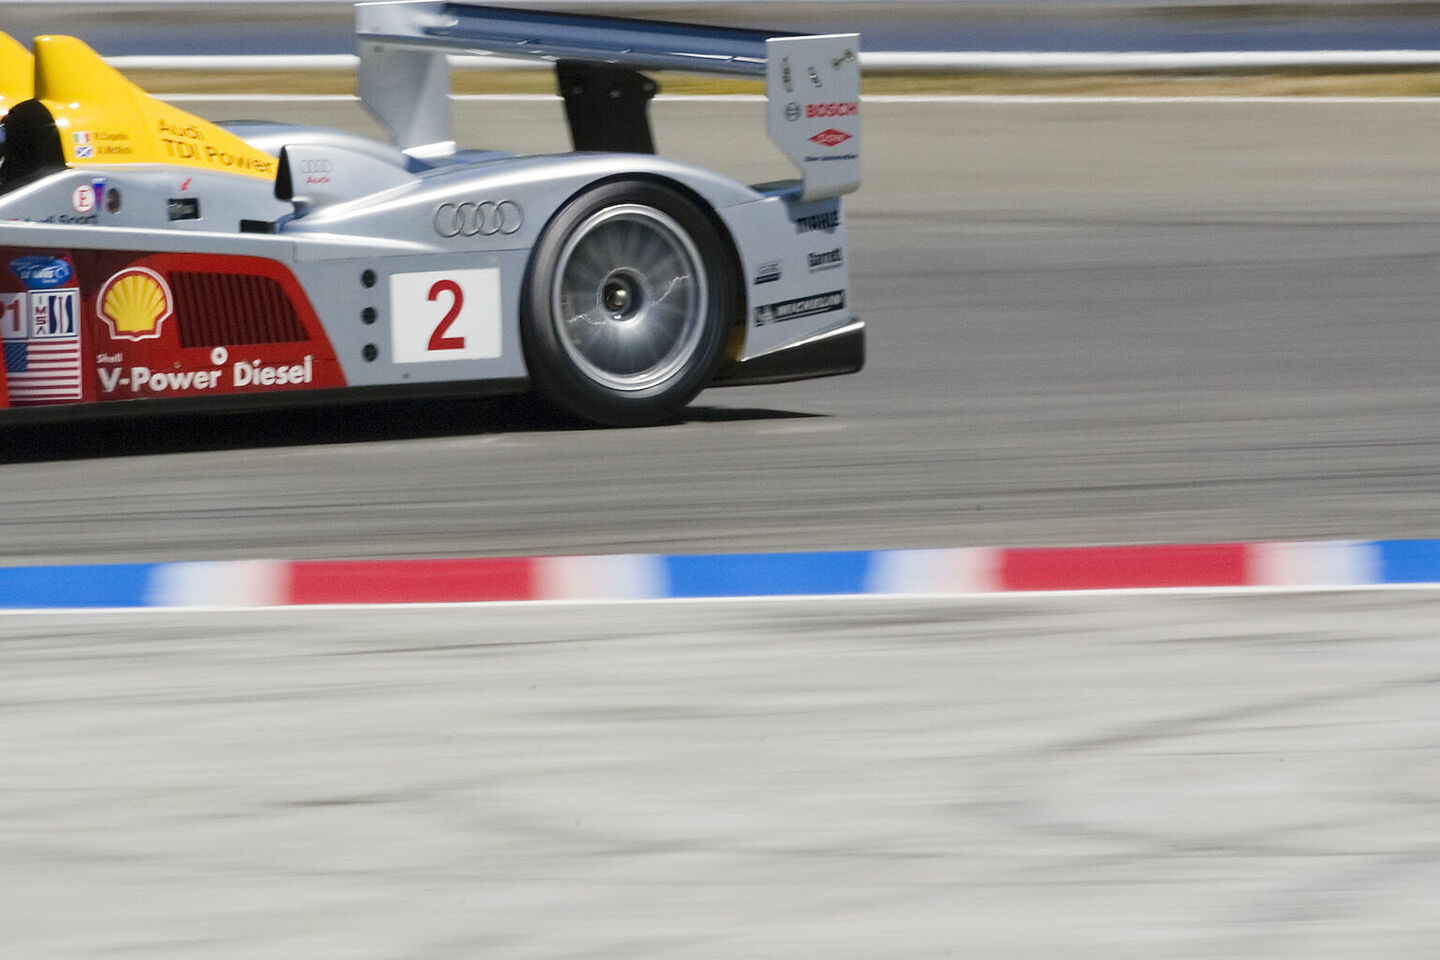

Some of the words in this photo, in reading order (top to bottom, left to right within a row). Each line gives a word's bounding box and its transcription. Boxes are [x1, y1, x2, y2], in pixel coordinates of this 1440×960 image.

[805, 102, 858, 117] BOSCH
[159, 120, 201, 140] Audi
[161, 138, 202, 159] TDI
[206, 146, 273, 173] Power
[427, 279, 465, 351] 2
[96, 366, 222, 392] V-Power
[233, 354, 313, 387] Diesel
